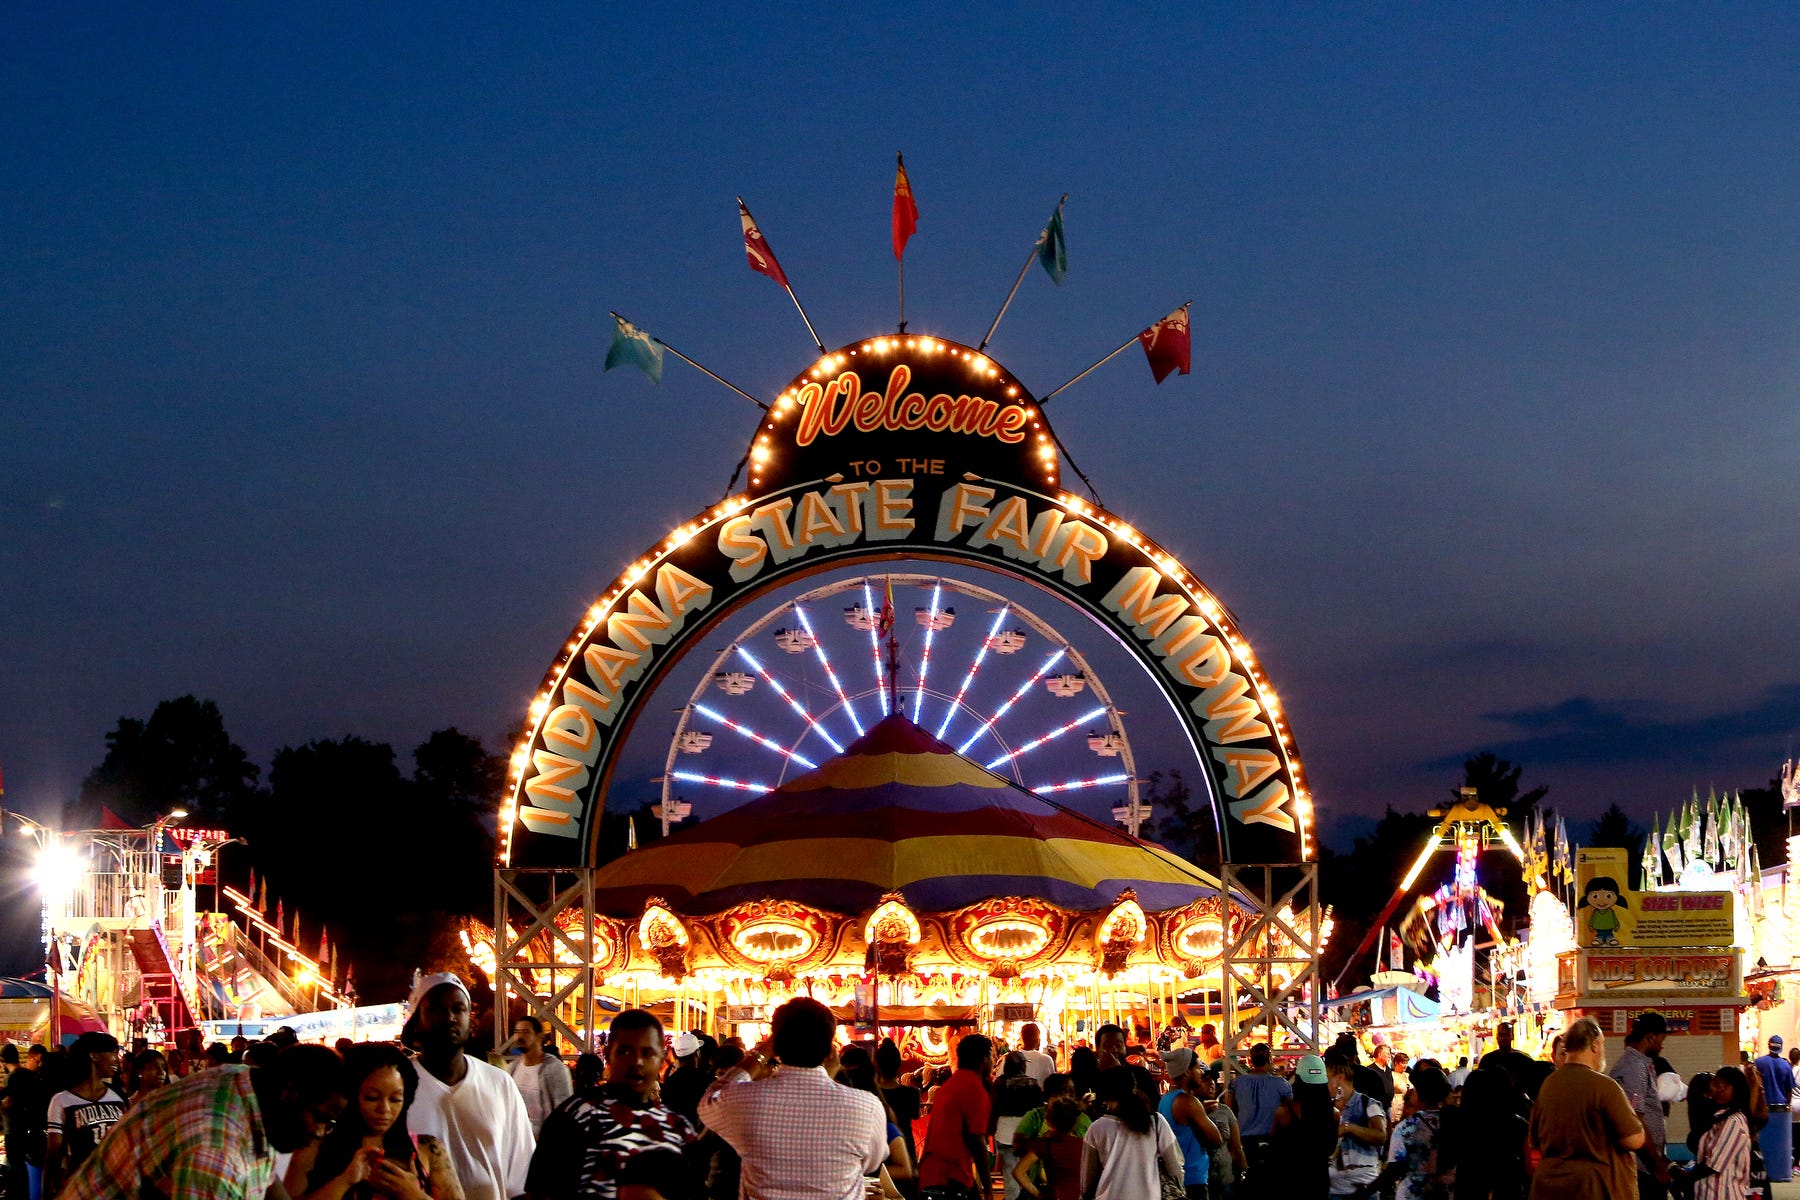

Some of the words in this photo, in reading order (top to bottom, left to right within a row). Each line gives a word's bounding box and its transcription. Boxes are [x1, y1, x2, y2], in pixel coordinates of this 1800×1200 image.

[796, 364, 1028, 447] Welcome
[849, 459, 882, 476] TO
[896, 458, 945, 475] THE
[520, 562, 713, 839] INDIANA
[718, 479, 916, 584] STATE
[935, 482, 1109, 587] FAIR
[1100, 566, 1296, 833] MIDWAY
[1591, 960, 1635, 981] RIDE
[1641, 957, 1730, 982] COUPONS
[1007, 1007, 1030, 1019] EXIT
